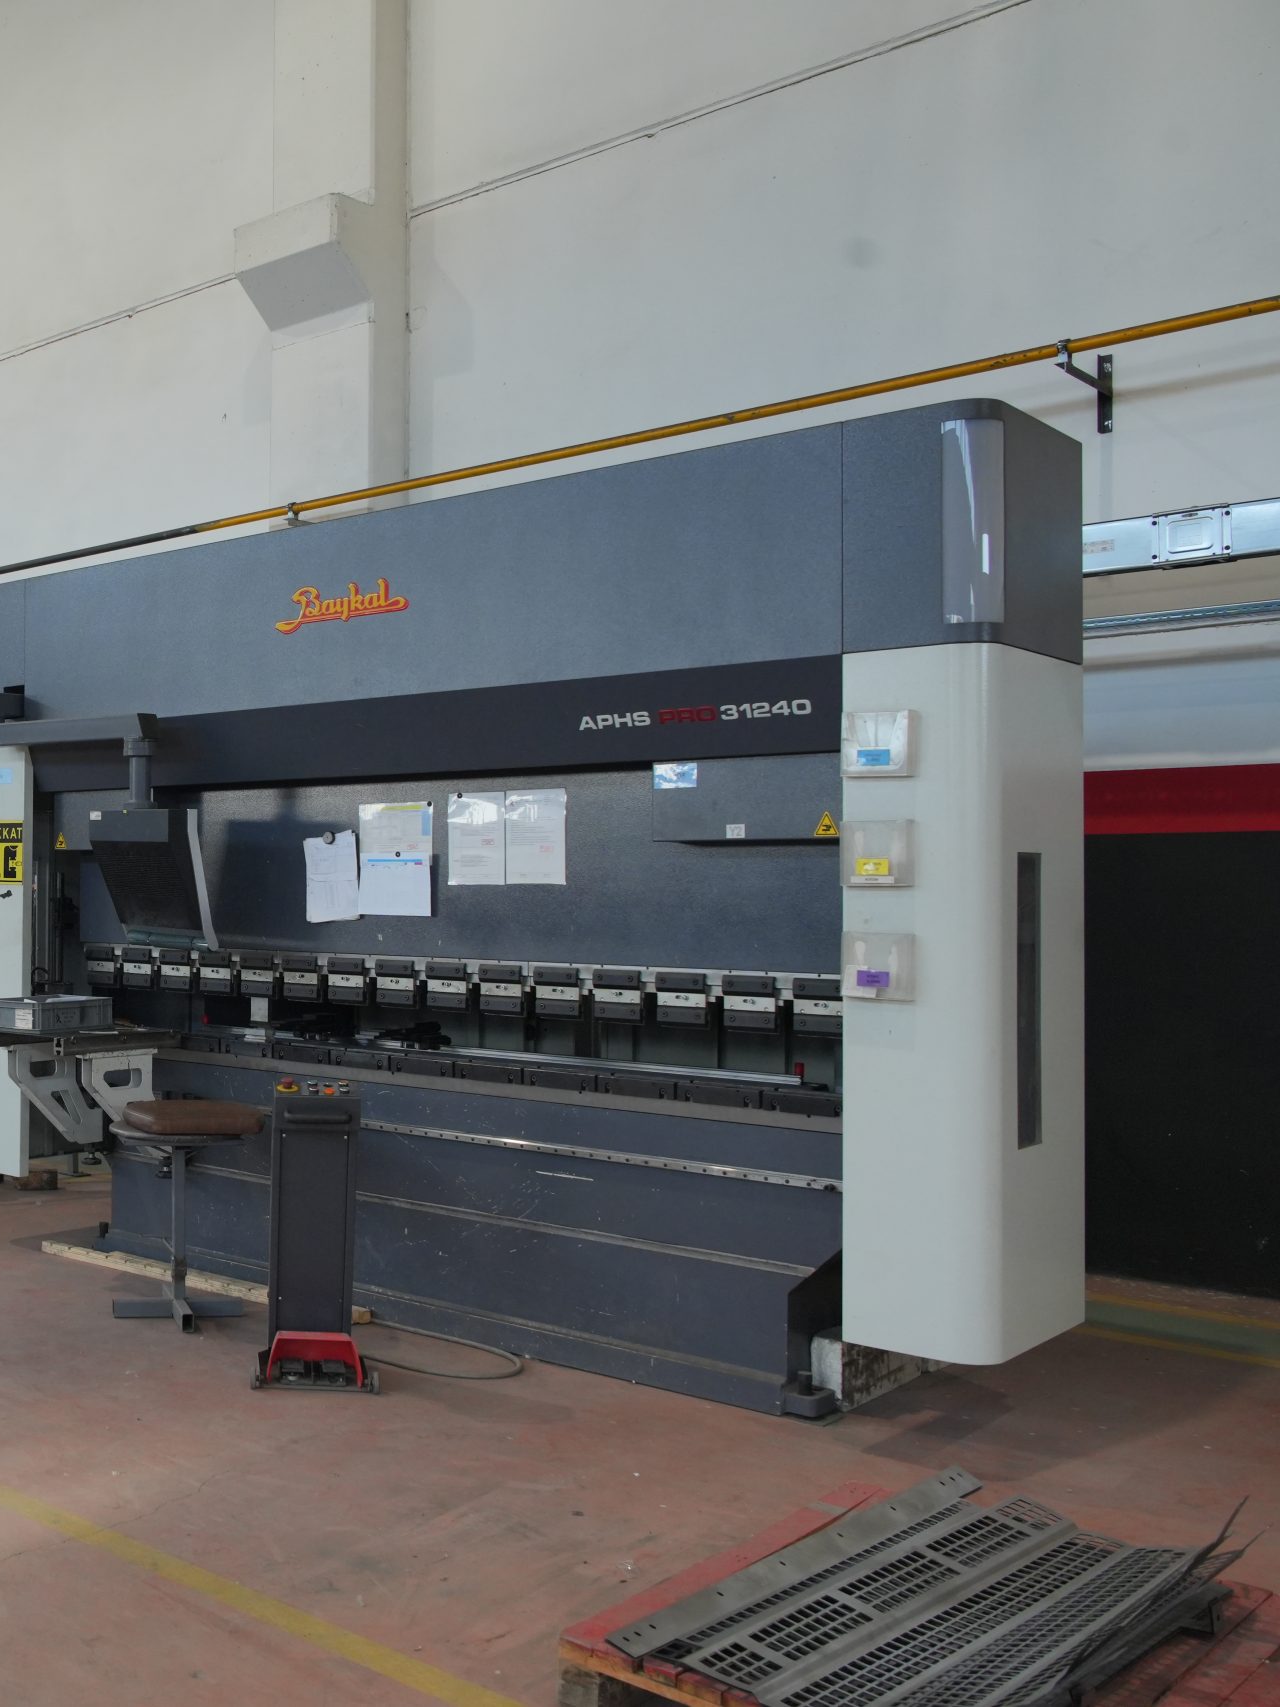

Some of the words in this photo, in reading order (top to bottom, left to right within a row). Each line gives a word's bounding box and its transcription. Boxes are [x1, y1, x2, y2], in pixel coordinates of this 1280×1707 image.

[274, 577, 409, 635] Baykal
[578, 711, 651, 731] APHS
[657, 704, 717, 725] PRO
[720, 698, 812, 721] 31240
[728, 825, 743, 837] Y2
